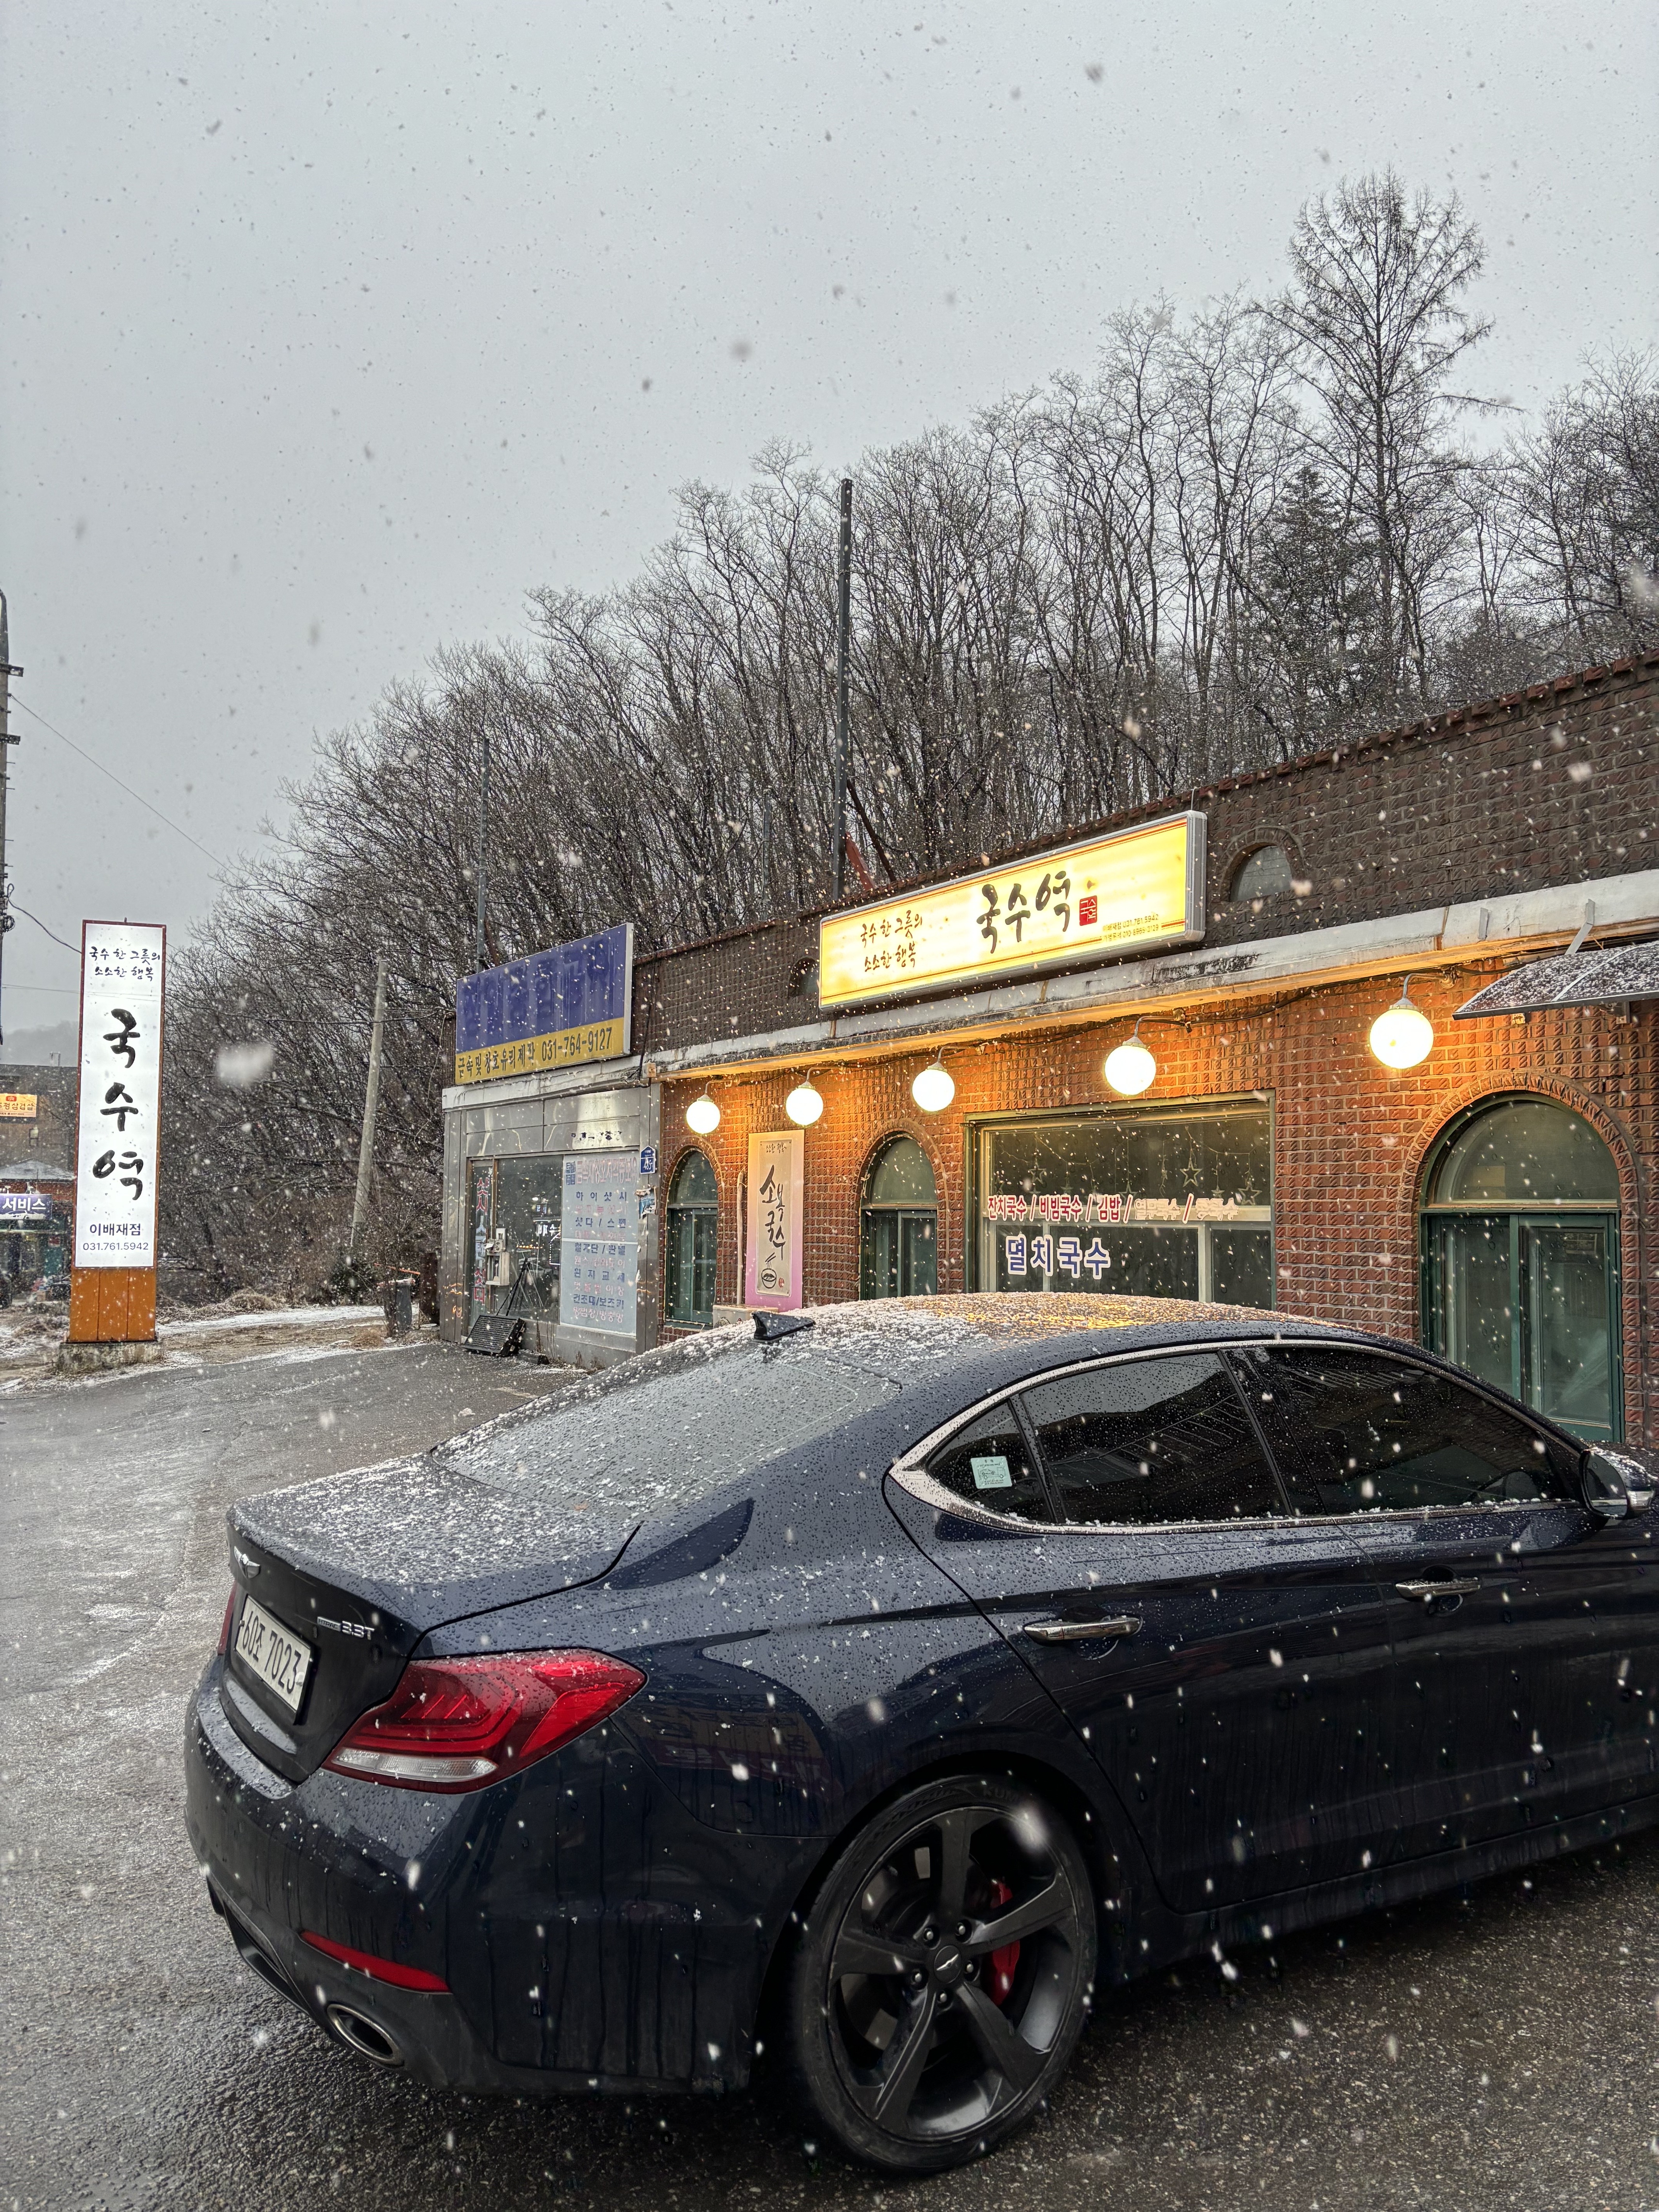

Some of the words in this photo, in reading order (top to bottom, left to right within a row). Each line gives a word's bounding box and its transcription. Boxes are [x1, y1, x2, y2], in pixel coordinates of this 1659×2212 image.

[977, 871, 1070, 953] 국수역
[861, 924, 876, 948] 국수
[880, 919, 891, 937] 한
[895, 910, 922, 938] 그릇의
[89, 946, 109, 961] 국수
[113, 948, 126, 959] 한
[130, 948, 160, 965] 그릇의
[865, 950, 891, 972] 소소한
[896, 941, 916, 968] 행복
[95, 966, 127, 977] 소소한
[131, 966, 153, 981] 행복
[542, 1027, 612, 1061] 031-764-9127
[93, 1008, 144, 1200] 국수역
[2, 1198, 46, 1211] 서비스
[988, 1195, 1027, 1221] 잔치국수
[1039, 1195, 1083, 1222] 비빔국수
[1097, 1194, 1121, 1222] 김밥
[90, 1223, 140, 1236] 이배재점
[1006, 1234, 1110, 1279] 멸치국수
[342, 1621, 374, 1640] 3.3T
[264, 1630, 302, 1694] 7023
